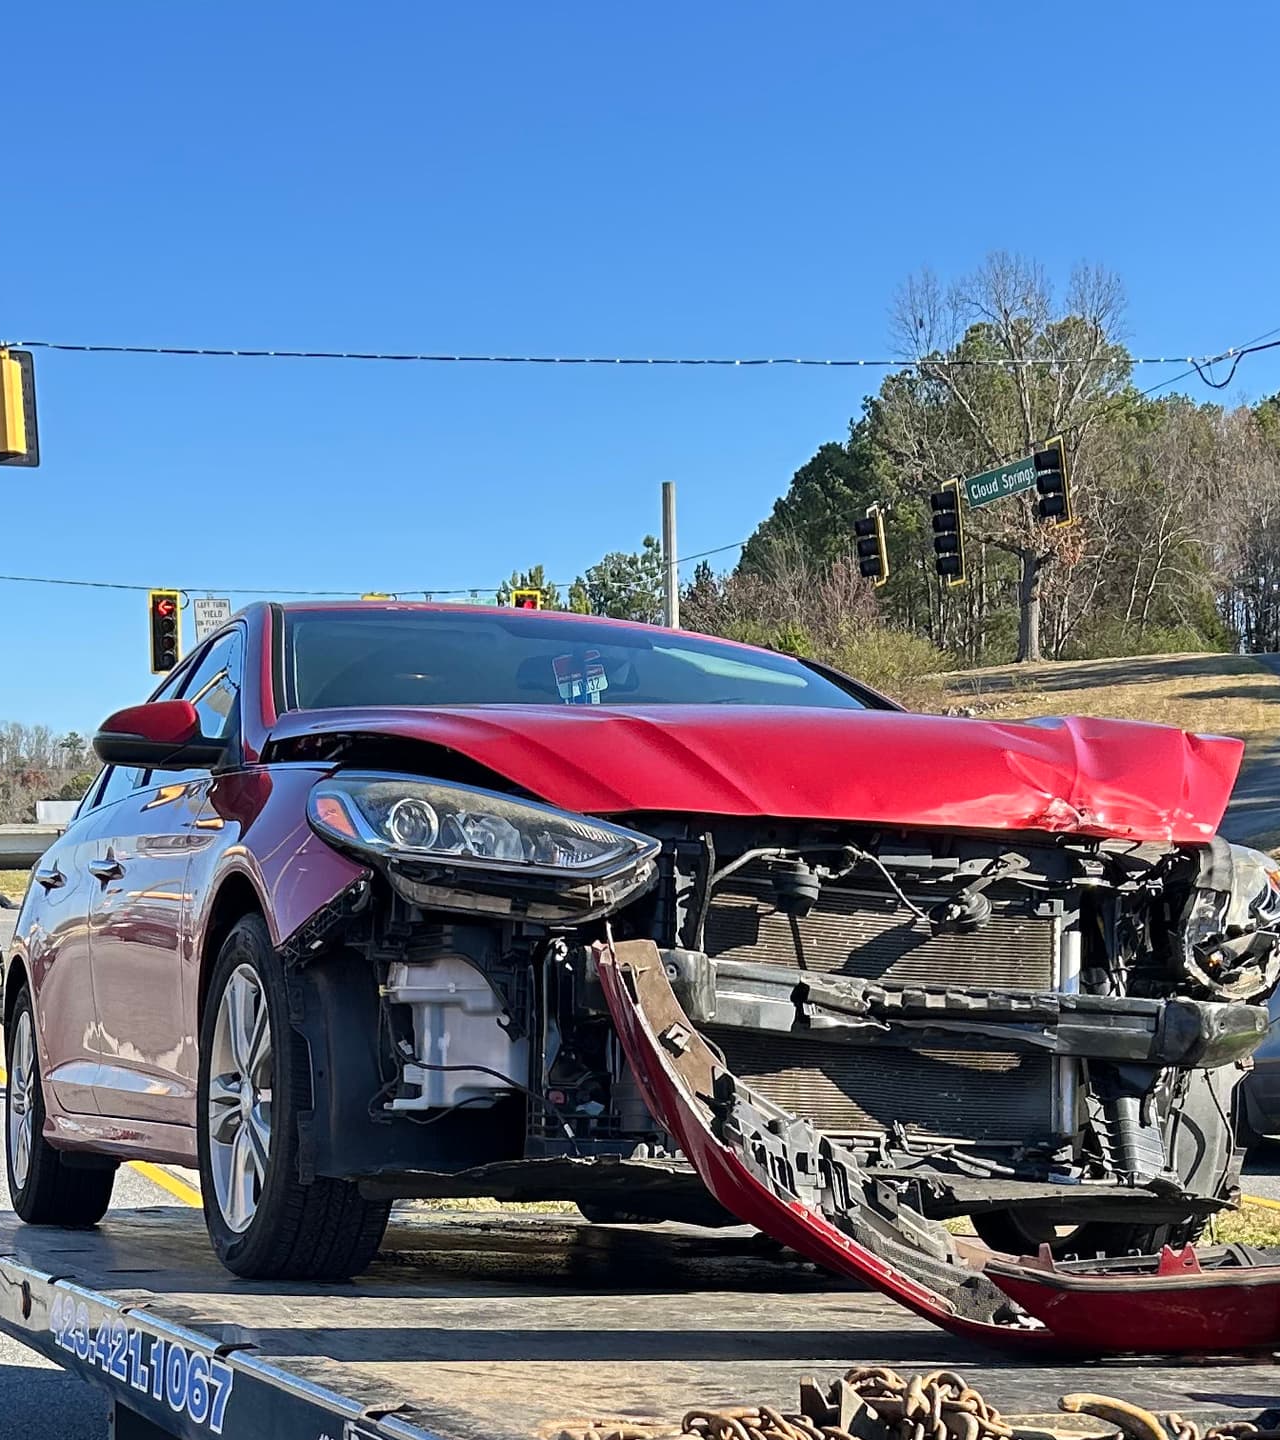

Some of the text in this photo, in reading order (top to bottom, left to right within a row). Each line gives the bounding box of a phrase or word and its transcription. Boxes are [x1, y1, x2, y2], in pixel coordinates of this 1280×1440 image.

[970, 466, 1034, 500] Cloud Springs
[203, 610, 223, 618] YIELD
[49, 1292, 234, 1435] 423.421.1067
